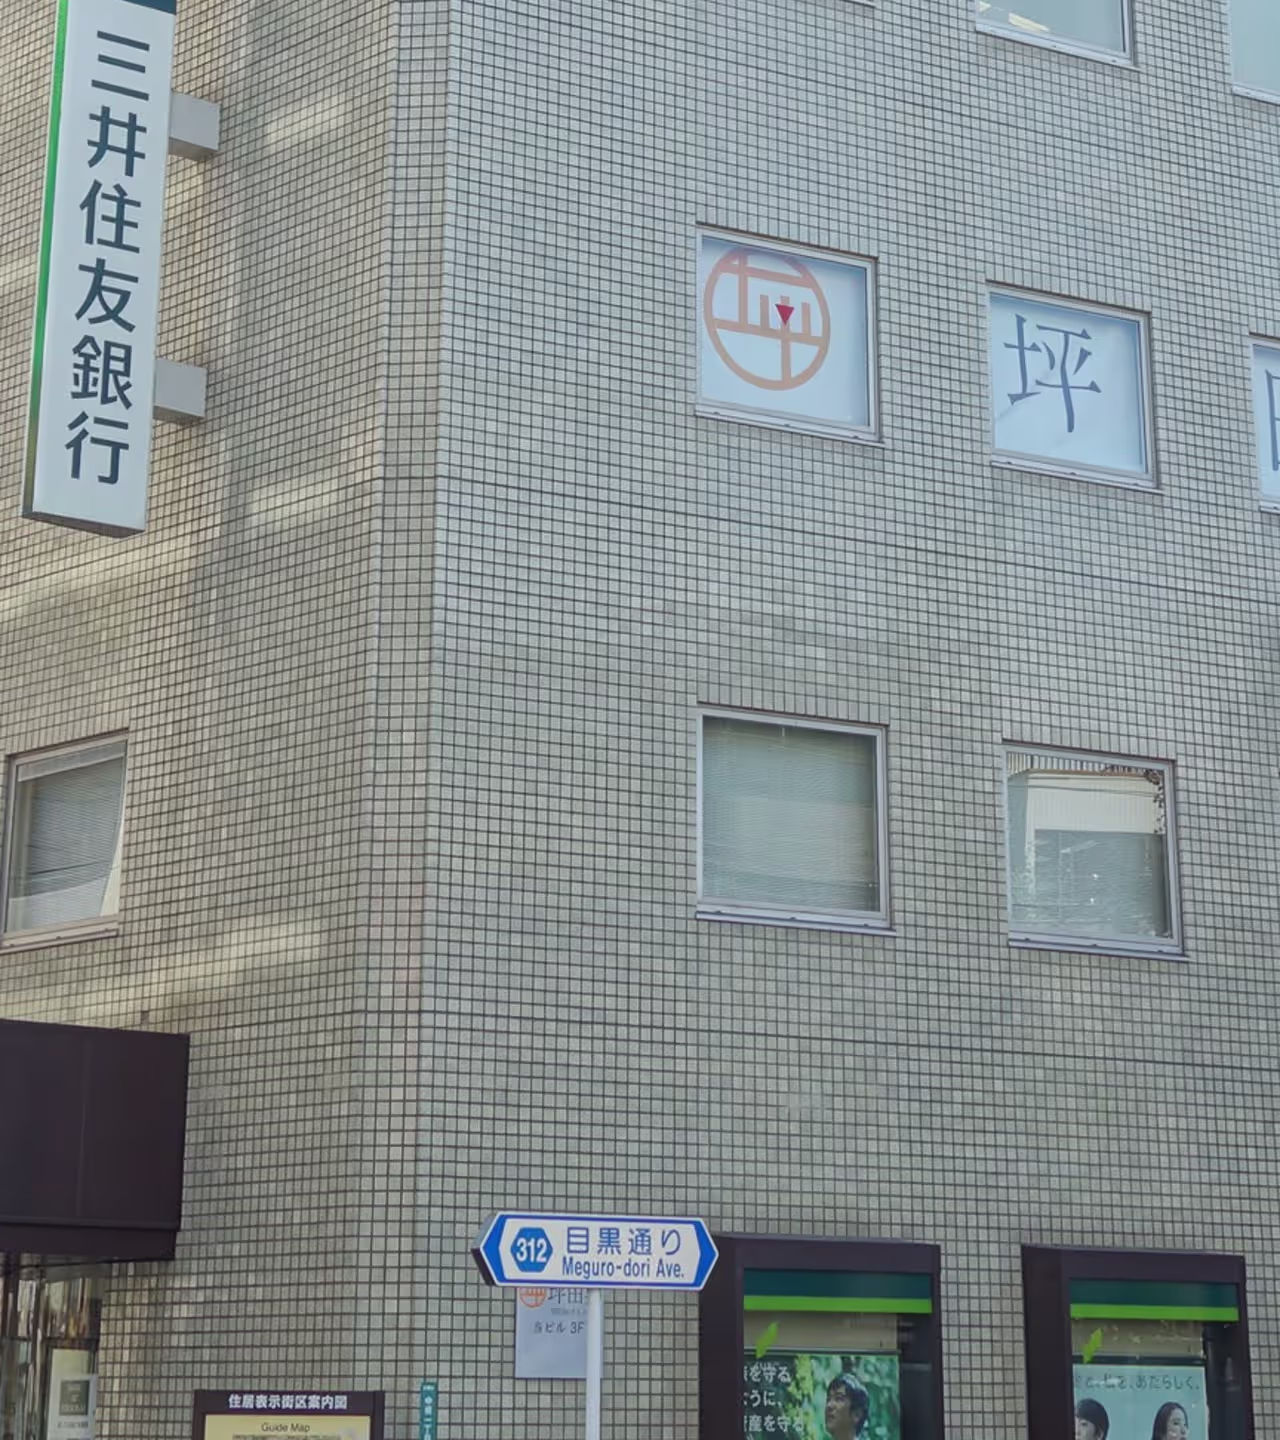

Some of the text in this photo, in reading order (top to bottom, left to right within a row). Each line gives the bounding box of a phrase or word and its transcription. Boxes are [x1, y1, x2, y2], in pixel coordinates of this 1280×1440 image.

[64, 29, 150, 485] 三井住友銀行
[516, 1226, 682, 1262] 312 目黒通り
[562, 1256, 685, 1280] Meguro-dori Ave.
[548, 1287, 588, 1305] 坪田
[570, 1321, 585, 1334] 3F
[743, 1364, 792, 1383] を守る
[228, 1394, 348, 1410] 住居表示街区案内図
[743, 1390, 784, 1408] うに、
[261, 1422, 311, 1433] Guide Map
[743, 1414, 805, 1432] 産を守る
